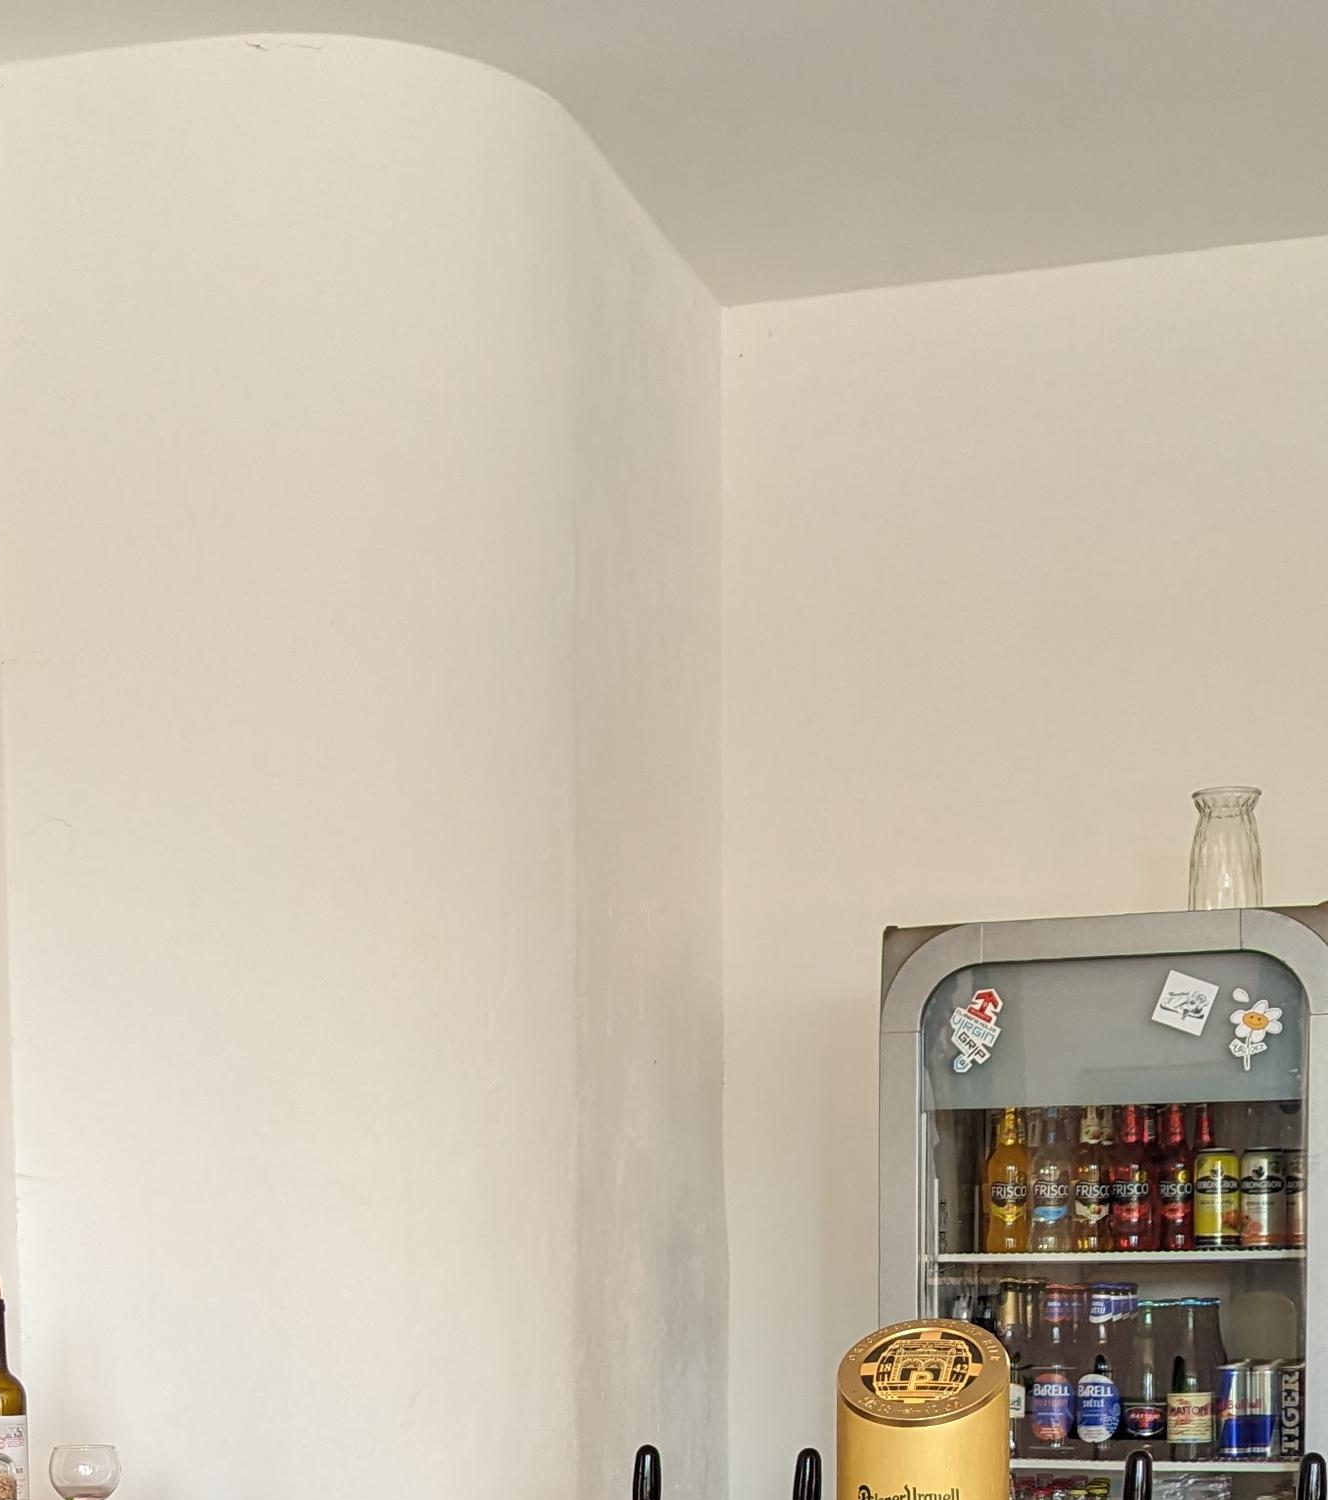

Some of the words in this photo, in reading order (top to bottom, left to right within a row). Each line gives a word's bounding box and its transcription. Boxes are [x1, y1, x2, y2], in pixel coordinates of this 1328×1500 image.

[953, 1015, 995, 1043] VIRGIN
[958, 1031, 986, 1059] GRIP
[991, 1184, 1027, 1198] FRISCO
[1160, 1182, 1192, 1195] RISCO
[879, 1362, 892, 1373] 18
[953, 1362, 968, 1373] 42
[1281, 1370, 1299, 1455] TIGER
